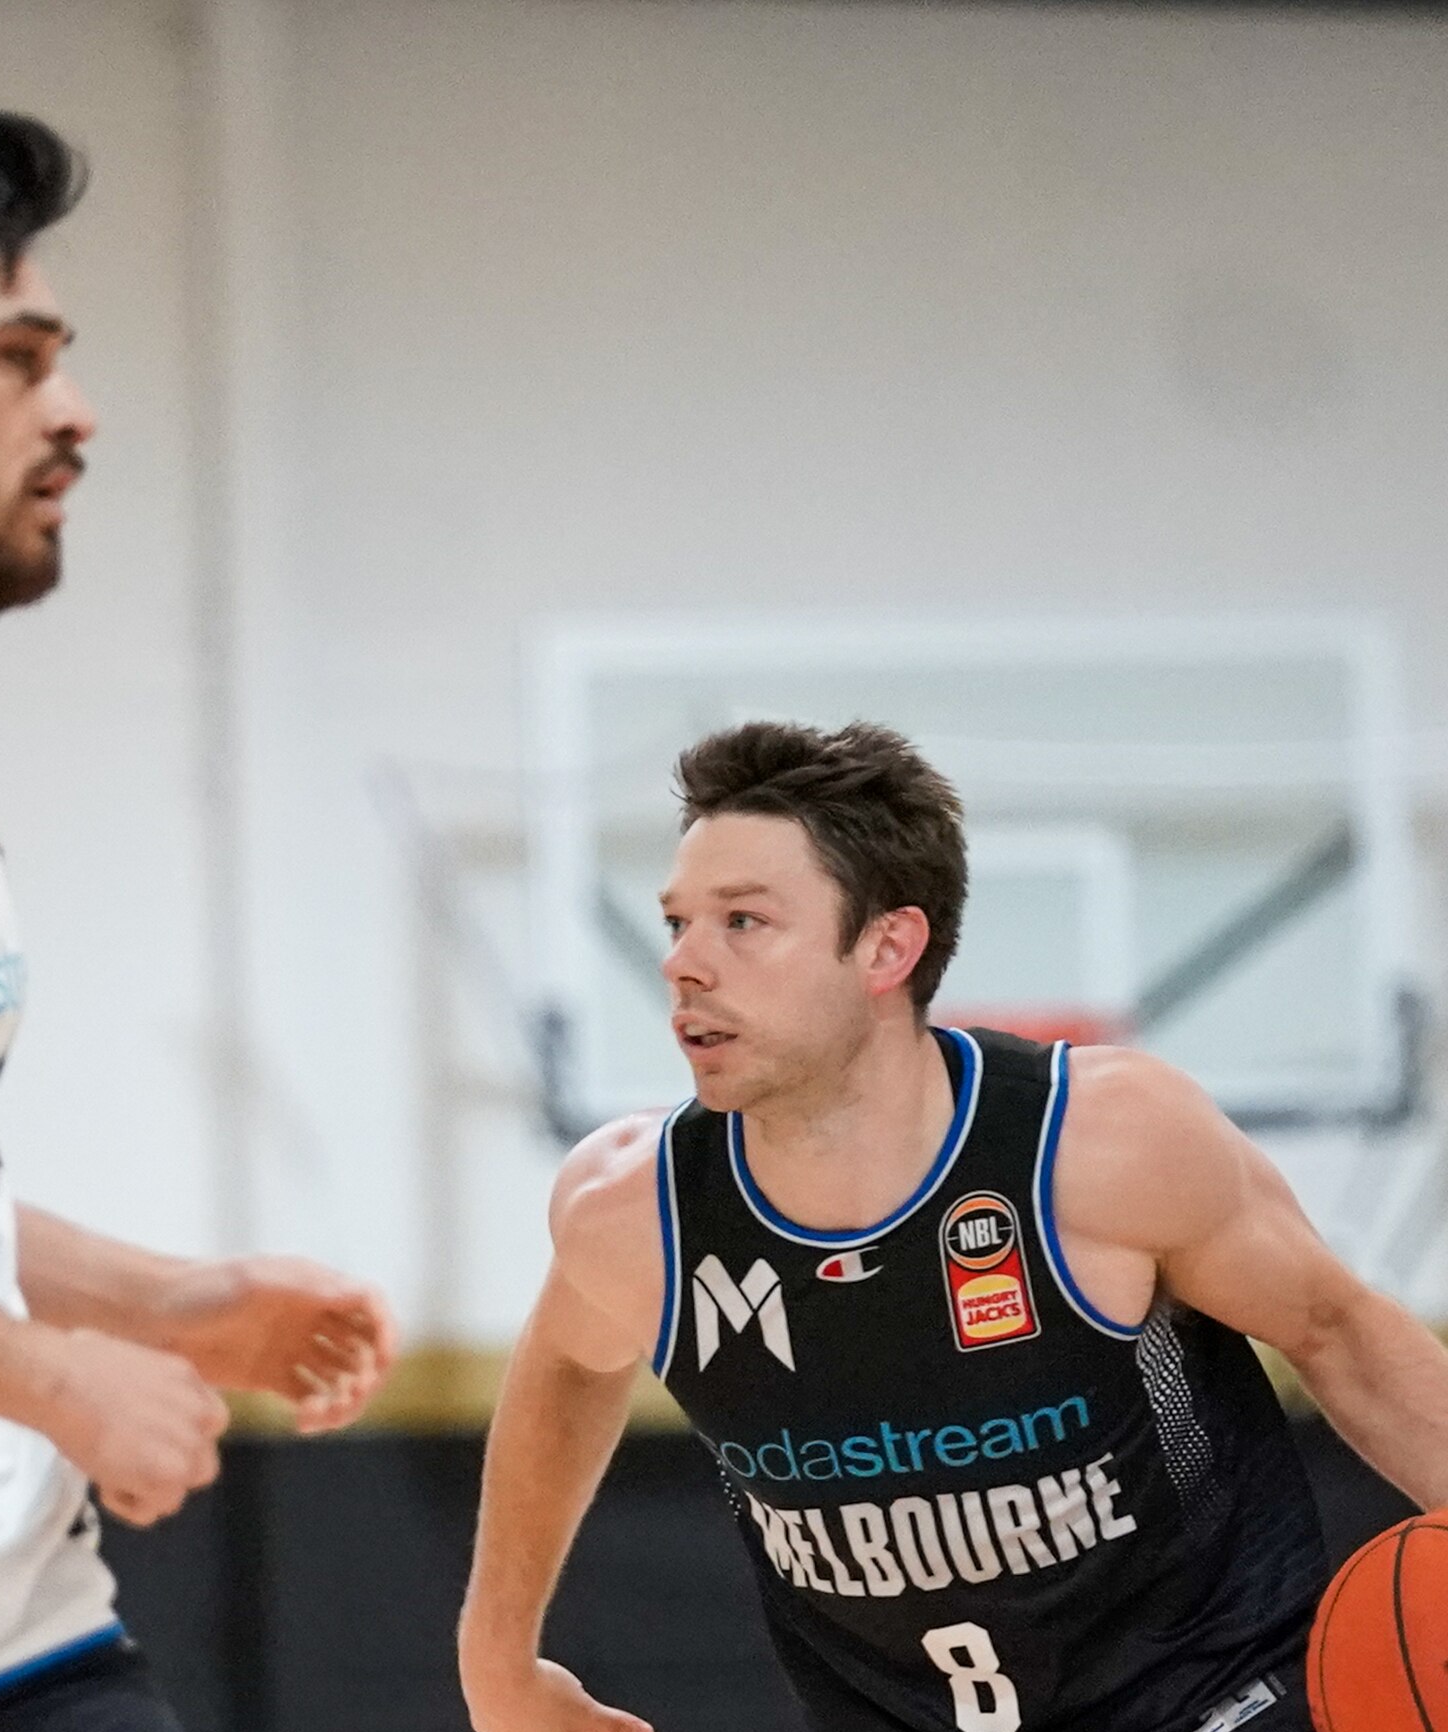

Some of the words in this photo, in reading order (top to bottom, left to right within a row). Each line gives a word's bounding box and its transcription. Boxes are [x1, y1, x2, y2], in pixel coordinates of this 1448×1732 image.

[958, 1215, 1003, 1251] NBL
[962, 1289, 1019, 1310] HUNGRY
[718, 1394, 1092, 1481] odastream
[745, 1452, 1138, 1598] MELBOURNE
